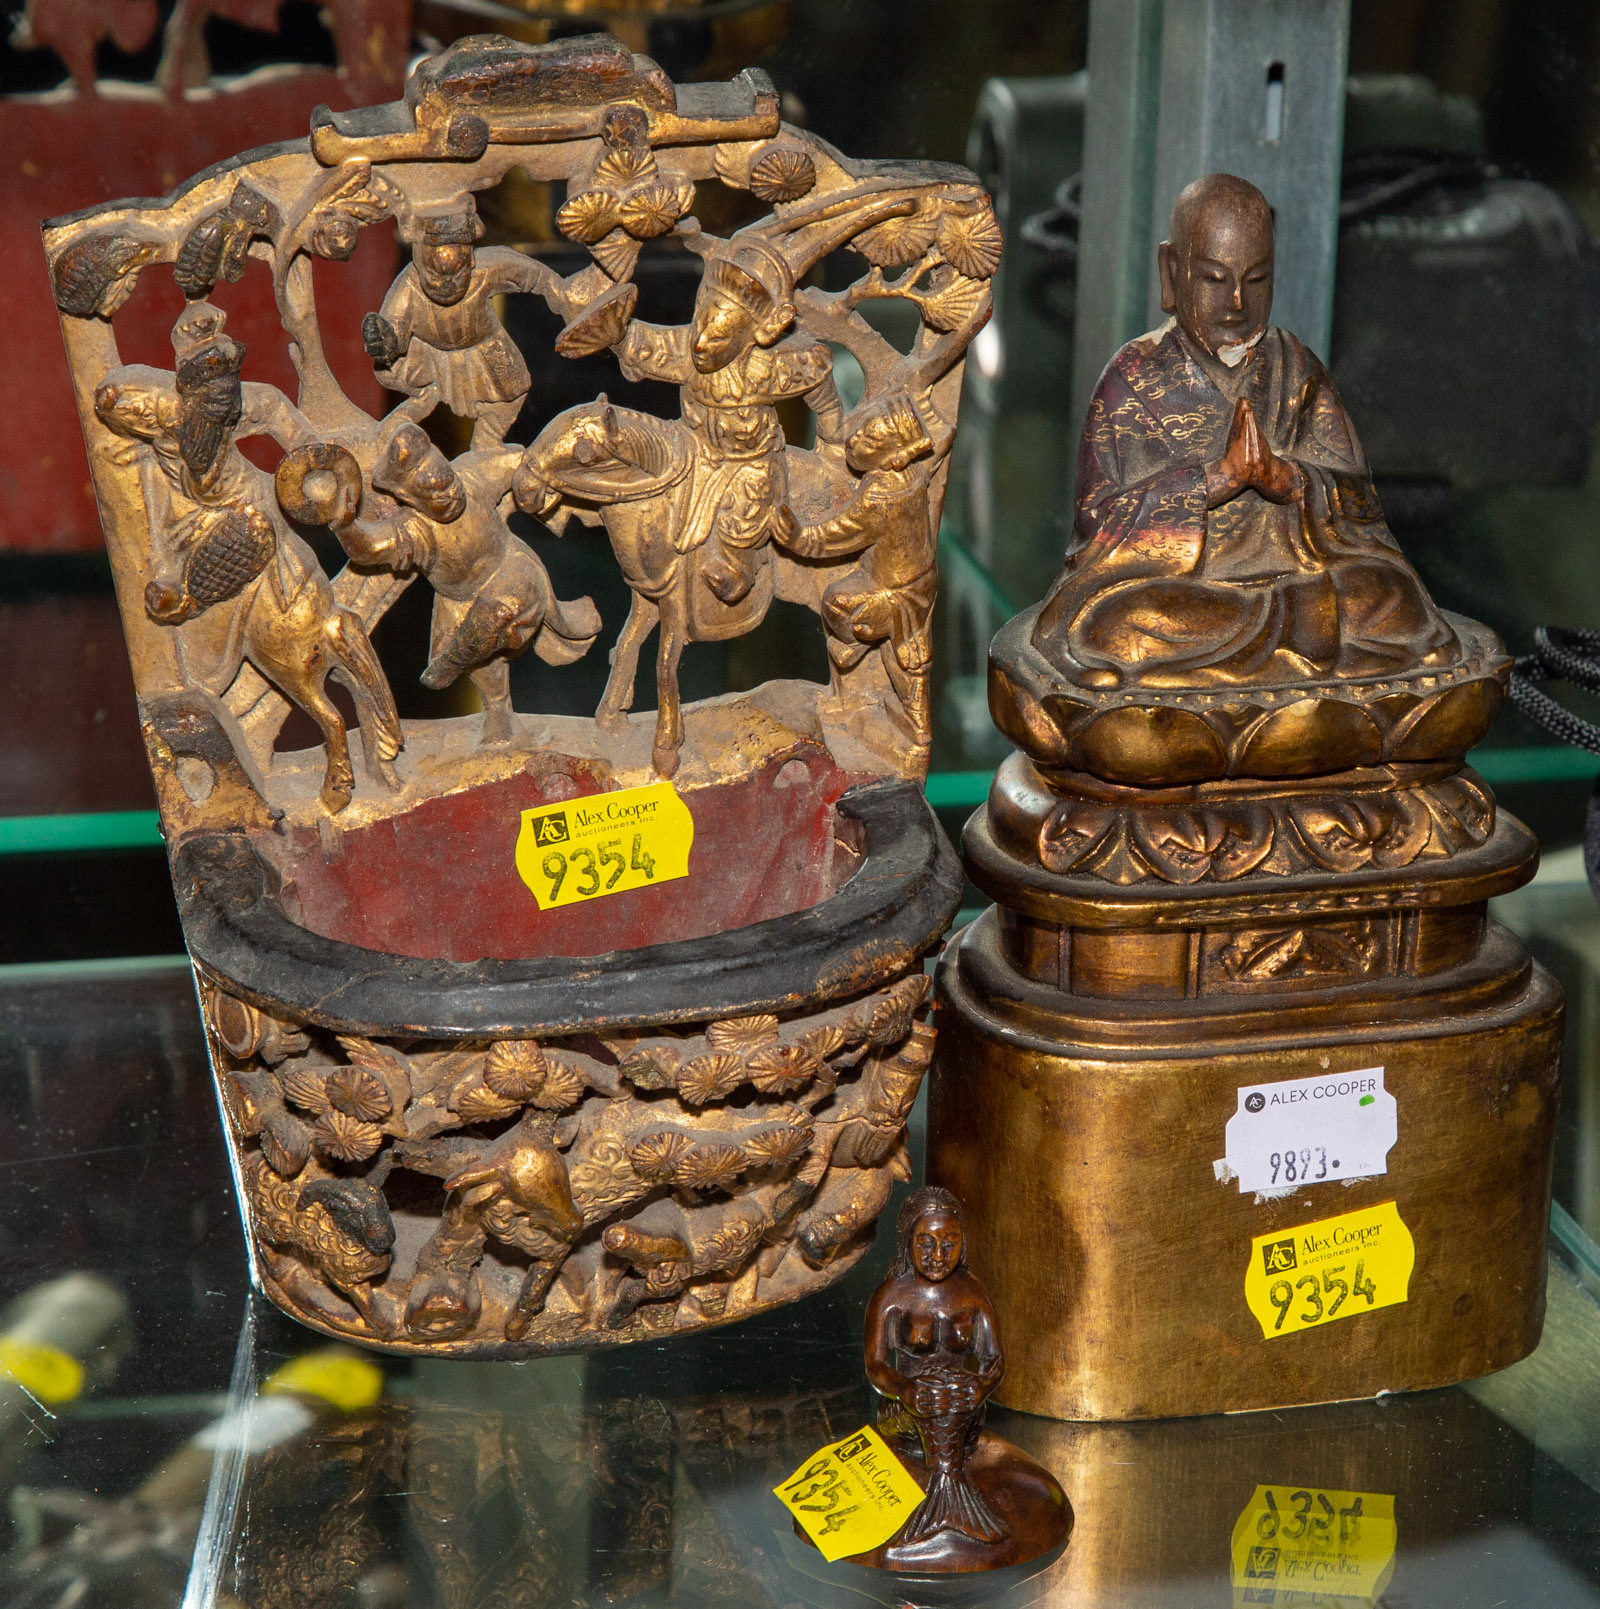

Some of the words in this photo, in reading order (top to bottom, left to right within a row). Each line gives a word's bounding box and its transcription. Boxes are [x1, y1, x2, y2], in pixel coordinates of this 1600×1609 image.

[574, 811, 604, 829] Alex
[606, 800, 659, 820] Cooper
[575, 819, 636, 838] auctioneers
[542, 833, 656, 902] 9354
[1270, 1089, 1308, 1105] ALEX
[1313, 1078, 1376, 1099] COOPER
[1301, 1236, 1331, 1255] Alex
[1333, 1223, 1383, 1245] Cooper
[1302, 1245, 1360, 1266] auctioneers
[1269, 1258, 1377, 1330] 9354
[846, 1463, 875, 1500] auctioneers
[855, 1452, 878, 1475] Alex
[871, 1469, 902, 1507] Cooper
[783, 1458, 860, 1536] 9354
